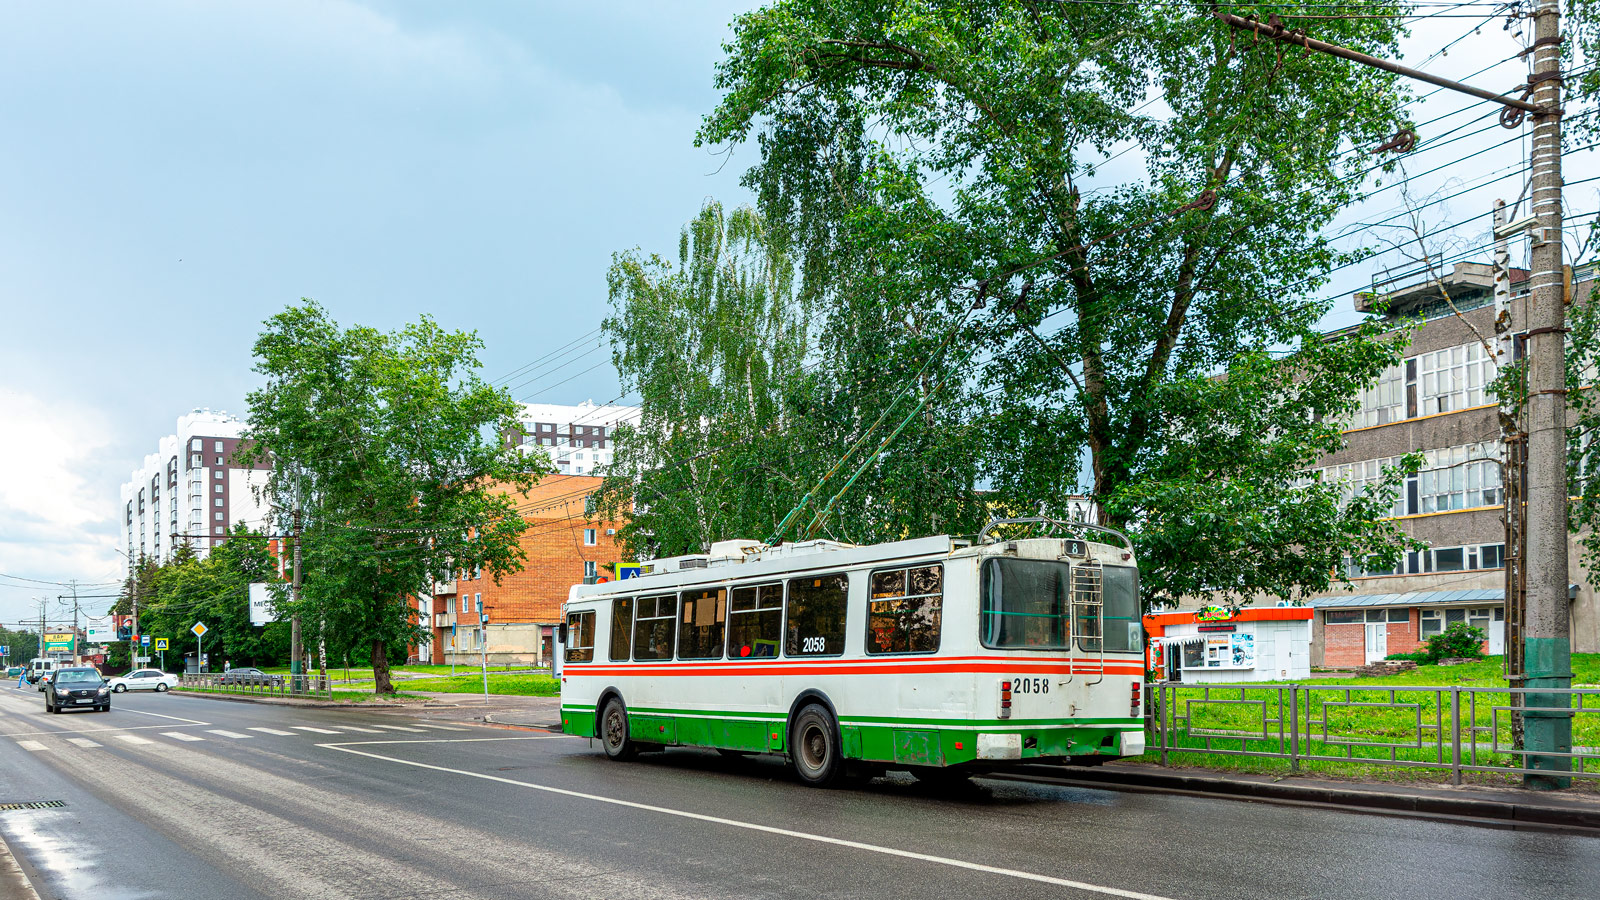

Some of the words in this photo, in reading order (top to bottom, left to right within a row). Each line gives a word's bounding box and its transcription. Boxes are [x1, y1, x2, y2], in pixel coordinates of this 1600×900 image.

[1072, 543, 1078, 554] 8
[803, 637, 825, 652] 2058
[1014, 678, 1049, 694] 2058
